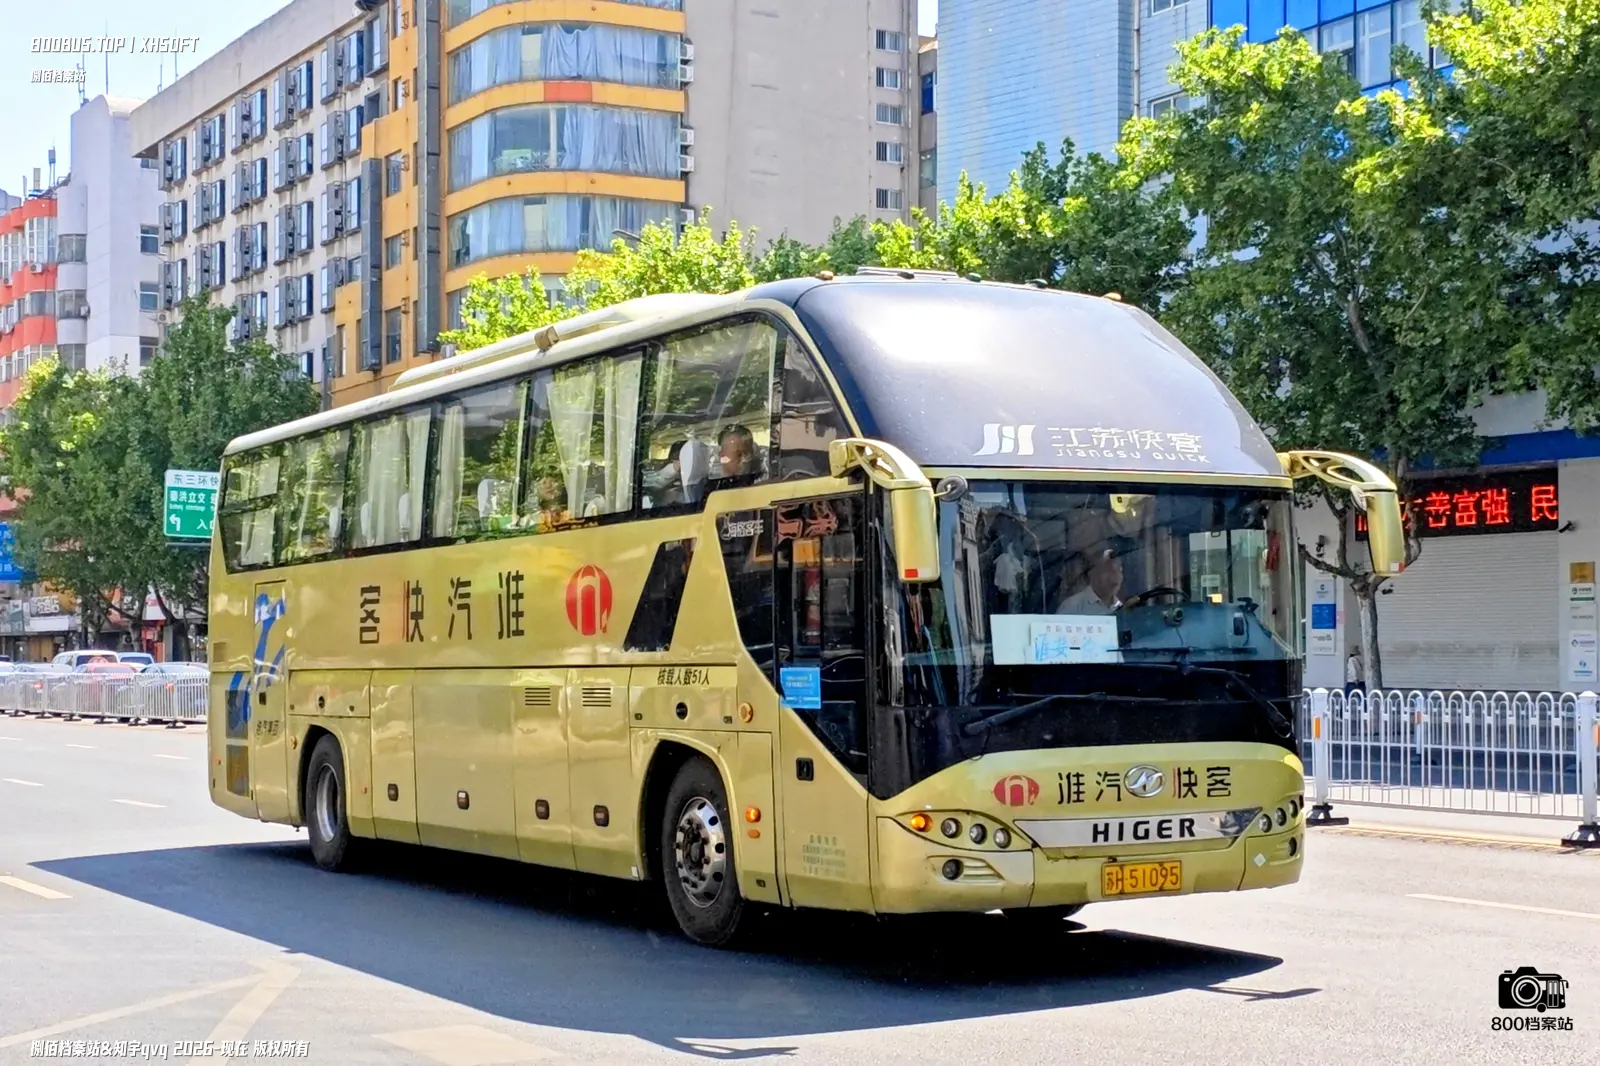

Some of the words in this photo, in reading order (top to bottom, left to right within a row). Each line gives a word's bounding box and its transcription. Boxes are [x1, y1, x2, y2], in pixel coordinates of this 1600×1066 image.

[1047, 426, 1202, 453] 江苏快客
[1173, 766, 1232, 799] 快客
[1092, 817, 1196, 844] HIGER
